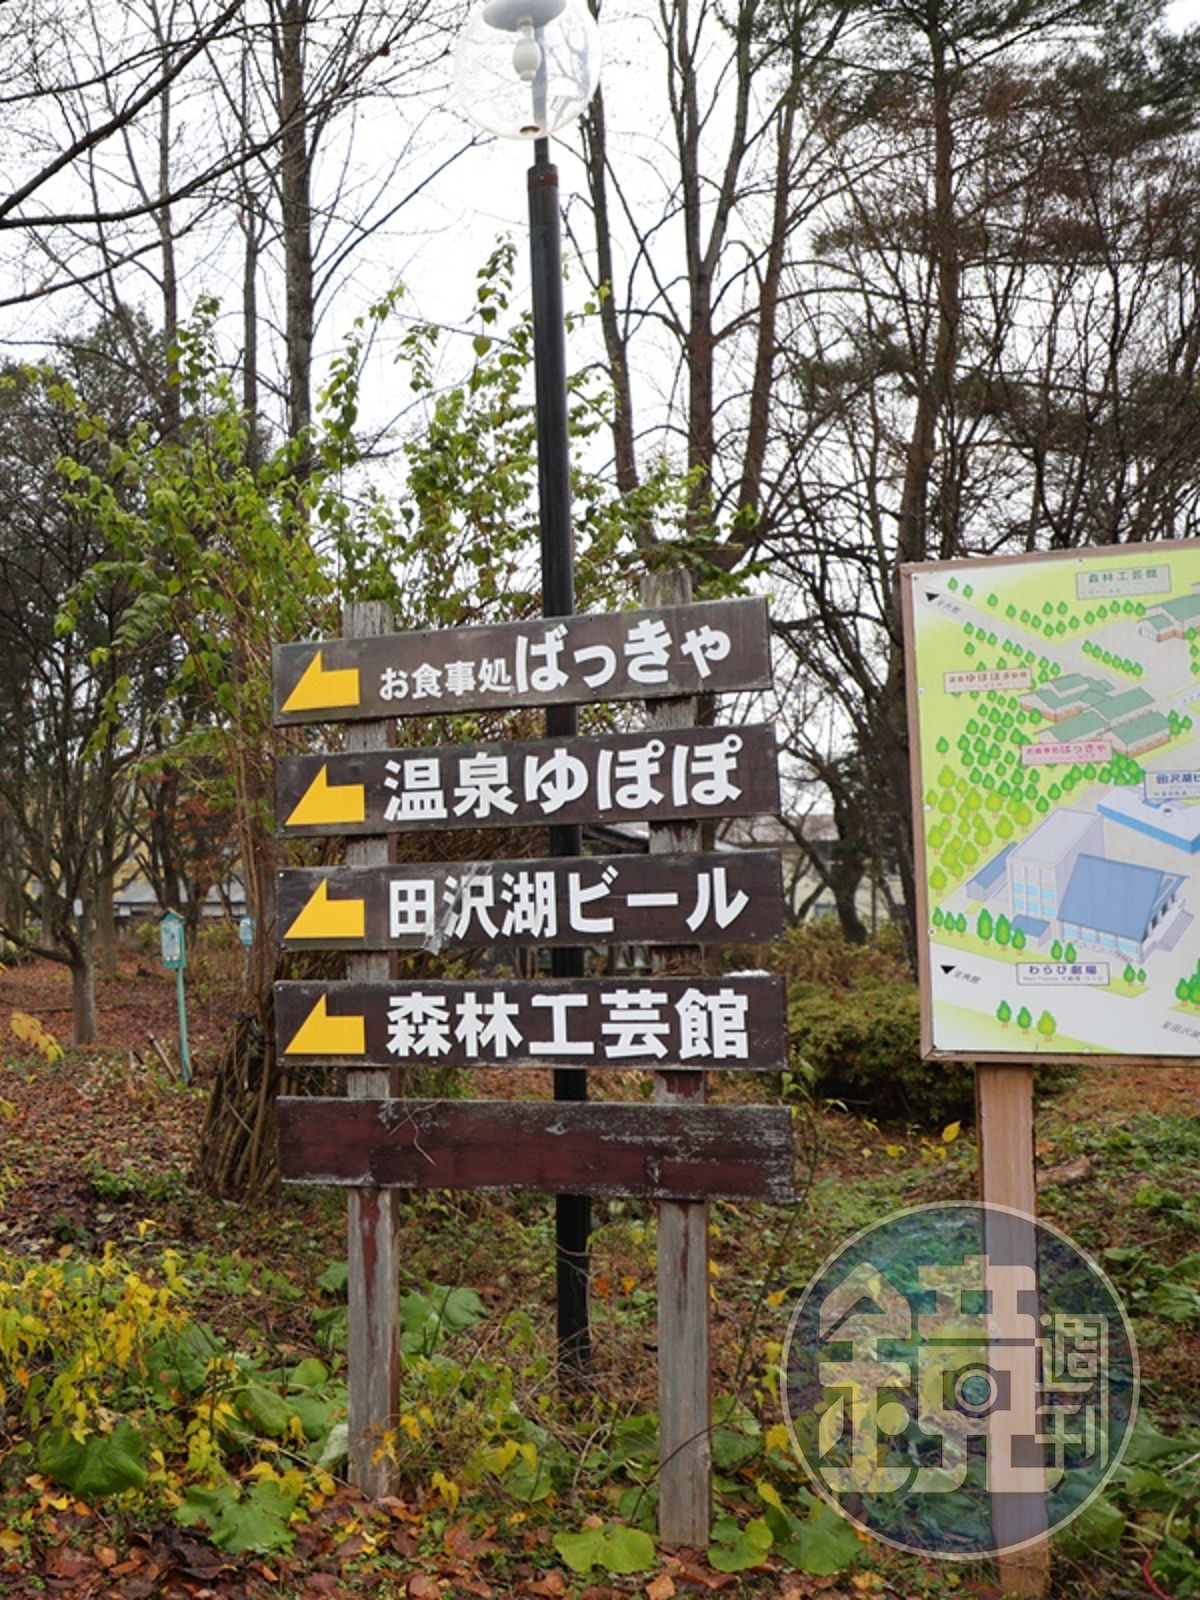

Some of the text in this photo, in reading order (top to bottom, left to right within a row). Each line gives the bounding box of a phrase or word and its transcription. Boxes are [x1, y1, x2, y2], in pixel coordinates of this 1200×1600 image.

[379, 618, 732, 701] お食事処ばっきゃ
[383, 732, 742, 823] 温泉ゆぽぽ
[389, 865, 749, 939] 田沢湖ビール
[386, 987, 749, 1060] 森林工芸館
